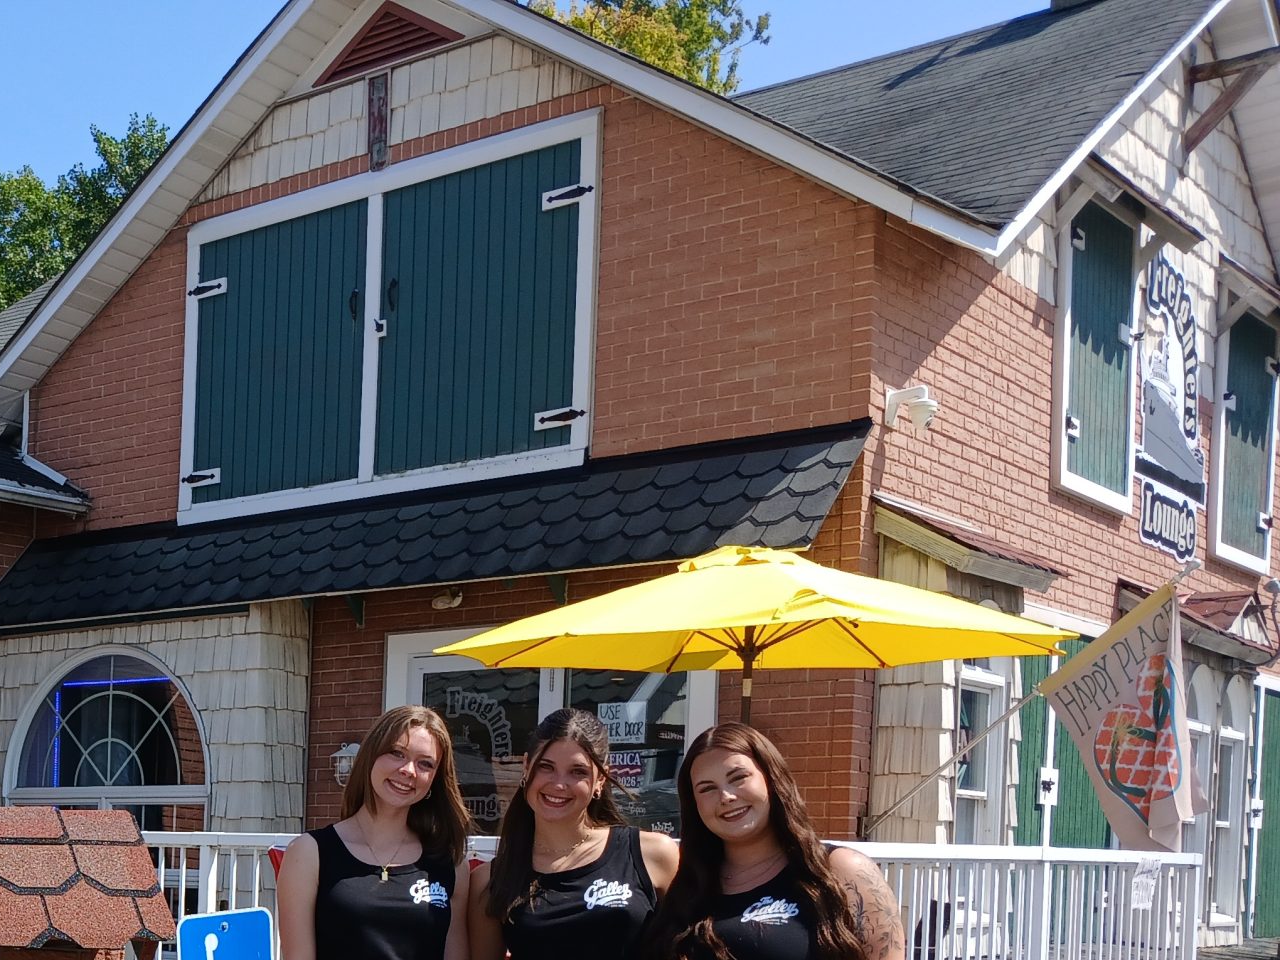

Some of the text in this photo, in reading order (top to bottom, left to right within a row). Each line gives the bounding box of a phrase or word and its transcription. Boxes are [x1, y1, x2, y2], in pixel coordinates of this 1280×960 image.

[1144, 489, 1195, 551] Lounge
[1055, 654, 1119, 736] HAPPY
[449, 690, 510, 759] Freighters
[600, 704, 621, 720] USE
[609, 753, 641, 766] ERICA
[584, 881, 632, 910] Galley
[741, 898, 799, 923] Galley
